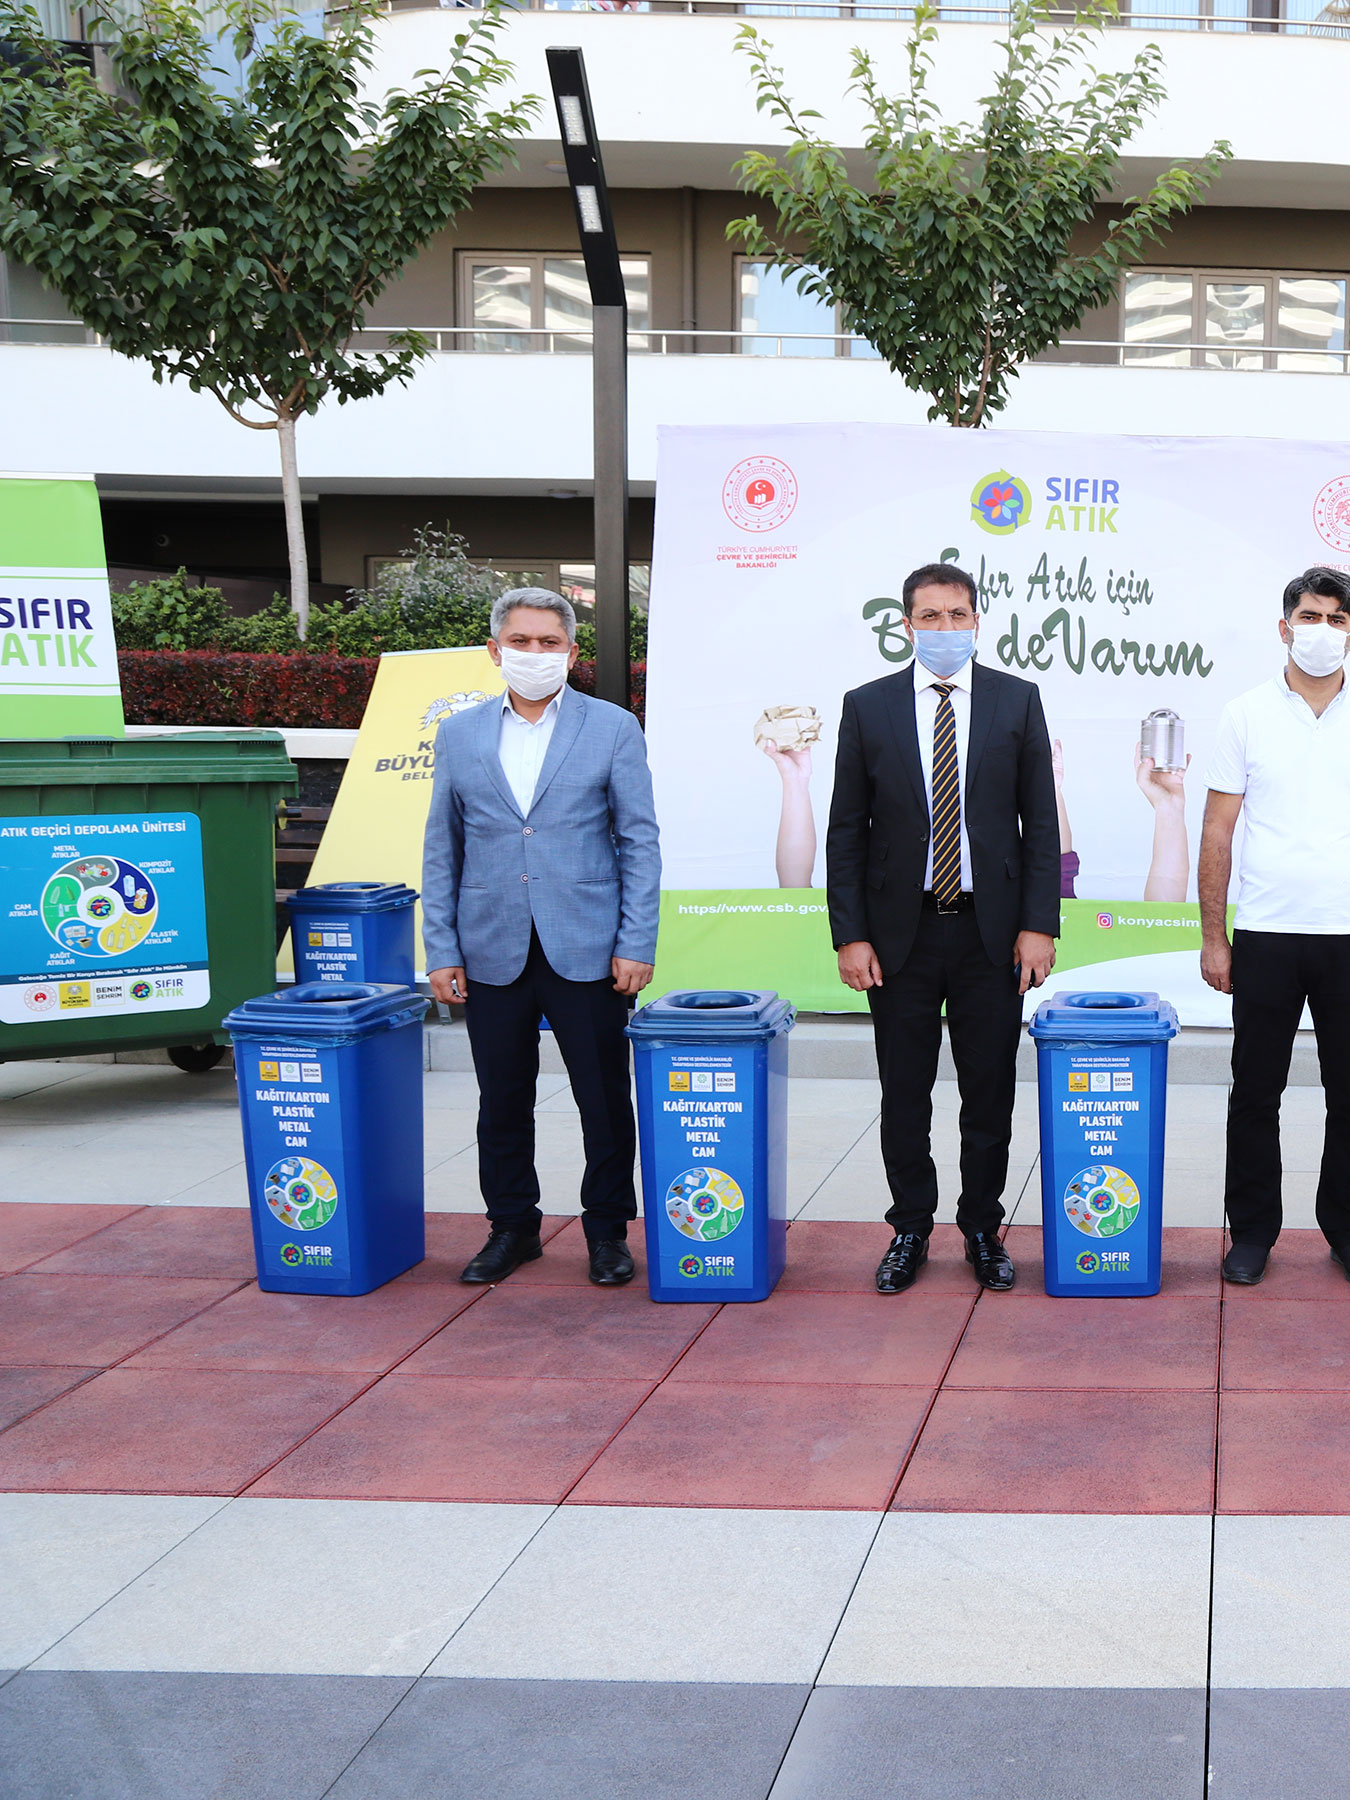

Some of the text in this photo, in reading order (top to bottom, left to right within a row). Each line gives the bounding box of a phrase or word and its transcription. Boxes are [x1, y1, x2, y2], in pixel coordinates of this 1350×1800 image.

[1046, 477, 1120, 504] SIFIR
[1045, 504, 1119, 533] ATIK
[716, 554, 741, 562] ÇEVRE
[736, 561, 777, 569] BAKANLIĞI
[1027, 552, 1096, 603] Atık
[1107, 568, 1154, 616] için
[0, 597, 94, 630] SIFIR
[1, 632, 98, 668] ATIK
[1, 820, 186, 838] ATIK GEÇİCİ DEPOLAMA ÜNİTESİ
[8, 909, 38, 917] ATIKLAR
[678, 902, 829, 916] https//www.csb.gov.
[1117, 915, 1200, 928] konyacsim
[305, 951, 358, 961] KAĞIT/KARTON
[317, 961, 347, 971] PLASTİK
[321, 973, 344, 981] METAL
[155, 978, 184, 988] SIFIR
[156, 987, 184, 998] ATIK
[256, 1088, 330, 1103] KAĞIT/KARTON
[663, 1098, 743, 1113] KAĞIT/KARTON
[1062, 1098, 1139, 1112] KAĞIT/KARTON
[272, 1104, 315, 1118] PLASTİK
[680, 1114, 726, 1128] PLASTİK
[1079, 1113, 1123, 1127] PLASTİK
[279, 1121, 311, 1133] METAL
[686, 1131, 721, 1142] METAL
[1084, 1130, 1118, 1141] METAL
[285, 1136, 308, 1147] CAM
[692, 1146, 716, 1158] CAM
[1090, 1145, 1113, 1156] CAM
[303, 1245, 332, 1256] SIFIR
[305, 1255, 333, 1266] ATIK
[704, 1256, 735, 1266] SIFIR
[1101, 1251, 1130, 1262] SIFIR
[705, 1266, 735, 1277] ATIK
[1102, 1261, 1130, 1272] ATIK
